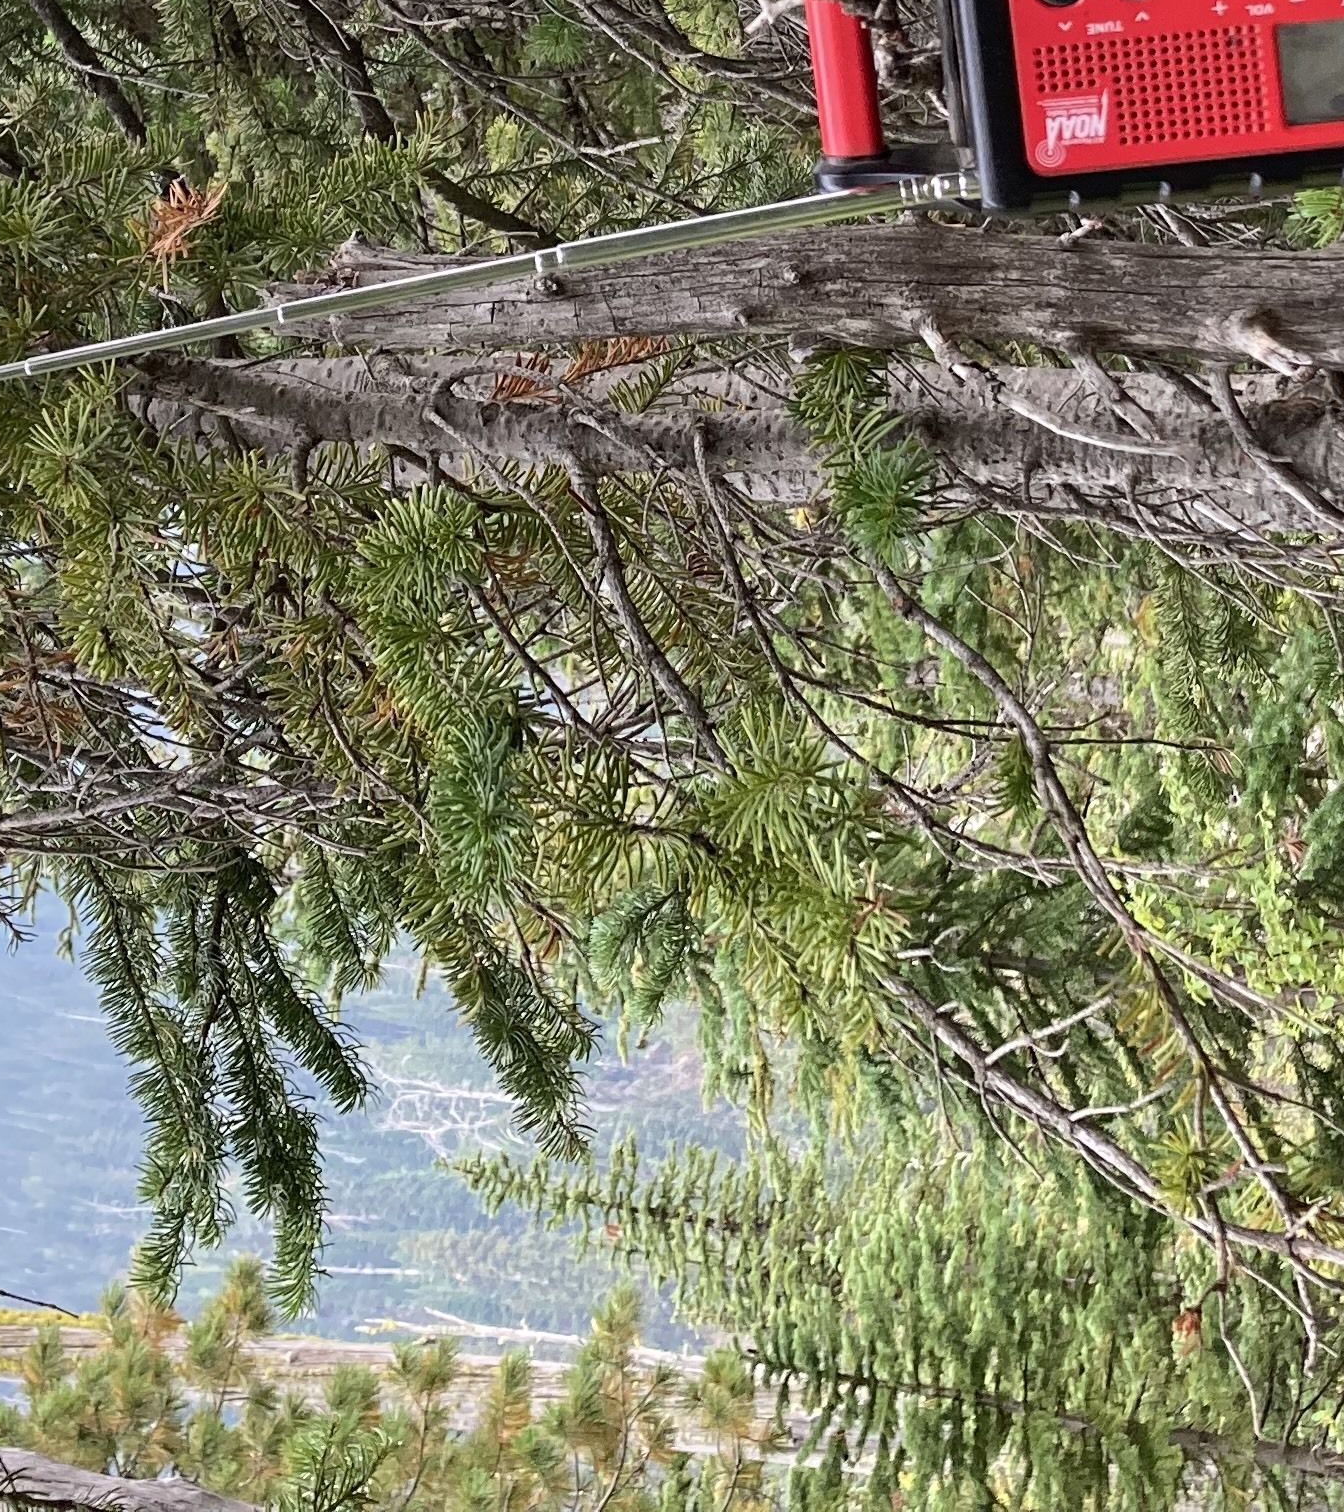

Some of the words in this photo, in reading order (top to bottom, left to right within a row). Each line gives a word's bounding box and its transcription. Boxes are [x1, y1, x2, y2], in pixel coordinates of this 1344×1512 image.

[1244, 2, 1274, 16] VOL
[1085, 20, 1124, 35] TUNE
[1045, 106, 1107, 141] NOAA
